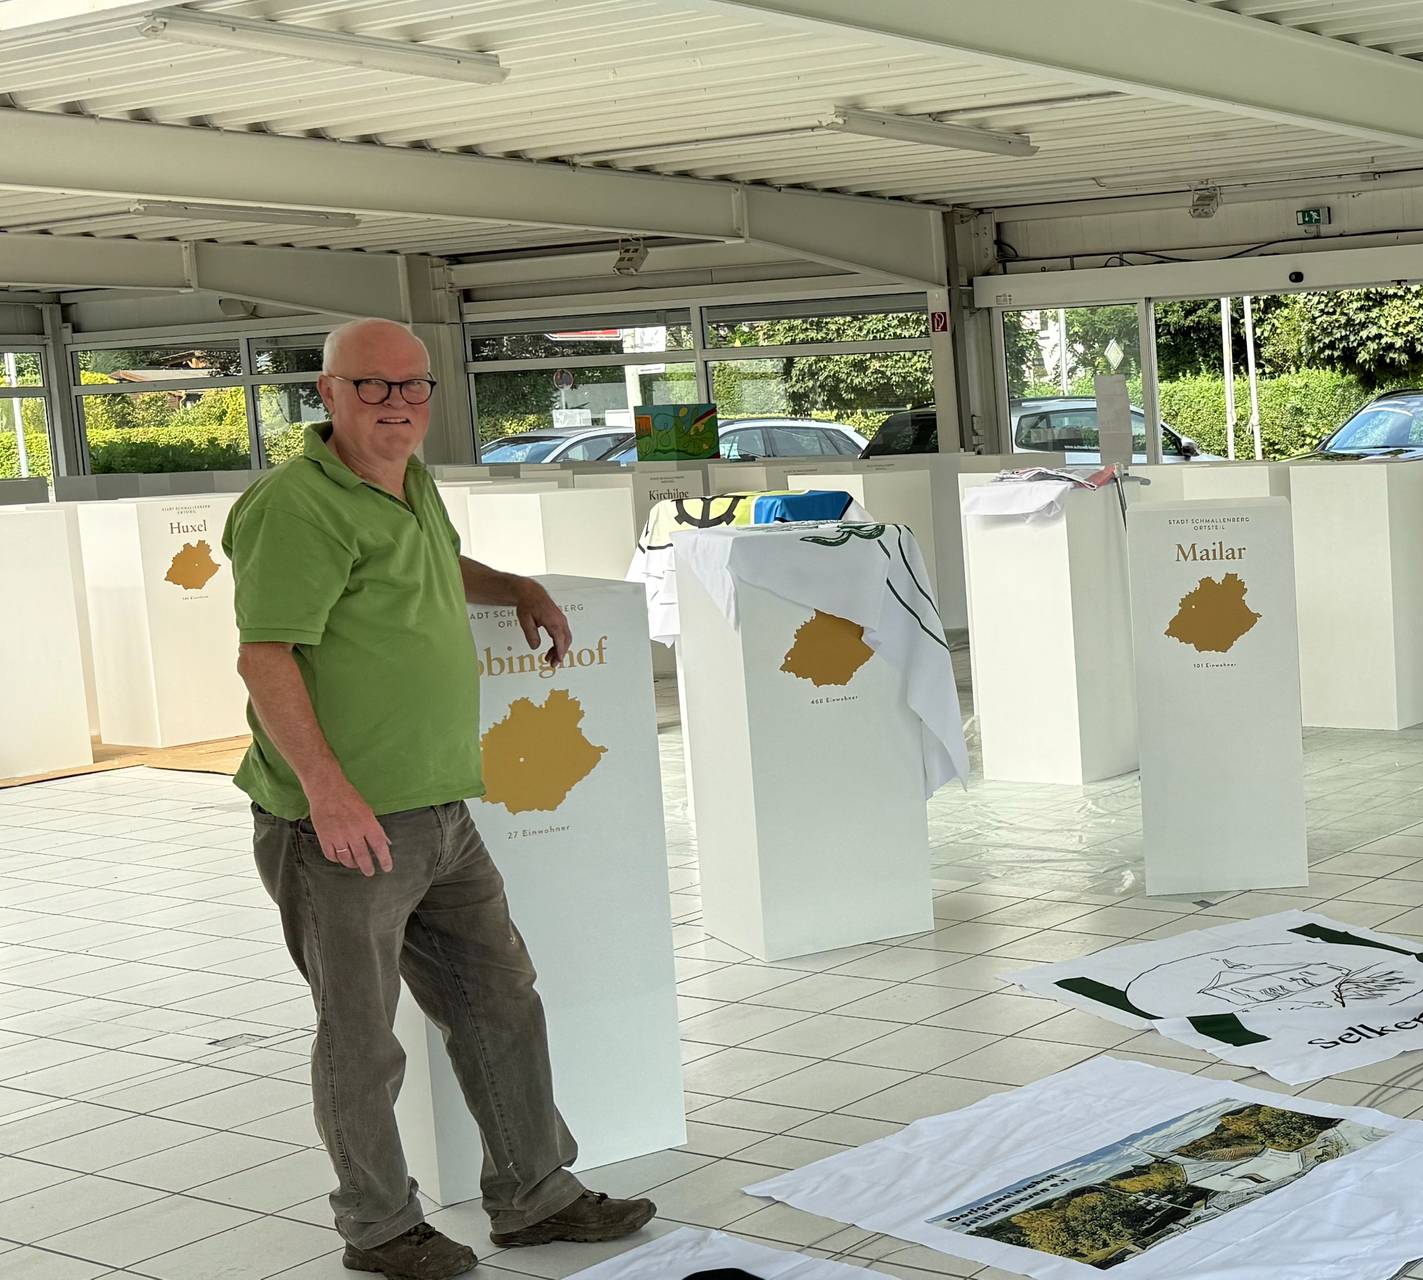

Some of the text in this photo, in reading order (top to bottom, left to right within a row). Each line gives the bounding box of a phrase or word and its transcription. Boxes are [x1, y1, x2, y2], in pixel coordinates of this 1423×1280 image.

[1191, 516, 1250, 524] SCHMALLENBERG
[169, 519, 207, 534] Huxel
[1175, 540, 1247, 562] Mailar
[470, 611, 490, 620] ADT
